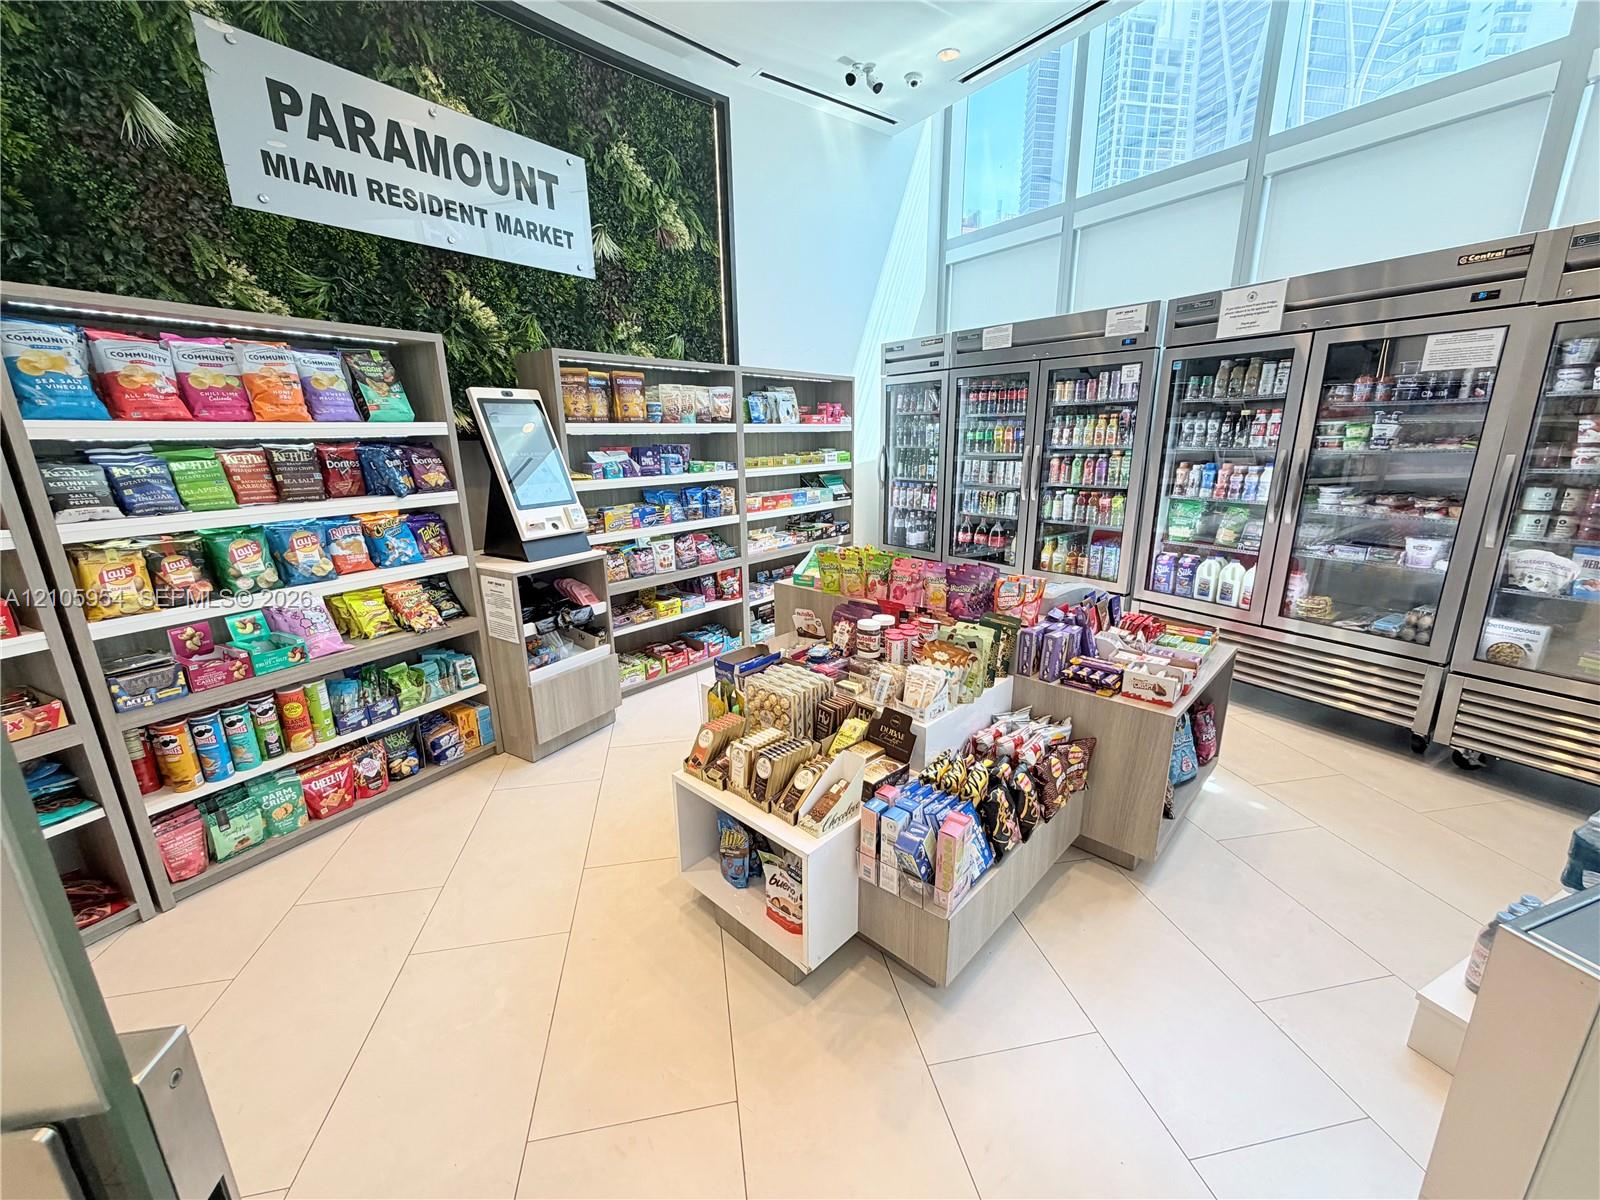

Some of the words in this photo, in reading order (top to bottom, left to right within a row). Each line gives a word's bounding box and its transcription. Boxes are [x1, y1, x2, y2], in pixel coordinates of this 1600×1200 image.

[265, 77, 559, 210] PARAMOUNT
[260, 149, 357, 197] MIAMI
[366, 177, 488, 229] RESIDENT
[495, 212, 574, 250] MARKET
[1469, 249, 1506, 262] Central
[6, 333, 76, 346] COMMUNITY
[110, 350, 168, 364] COMMUNITY
[181, 352, 236, 363] COMMUNITY
[248, 353, 293, 362] COMMUNIT
[34, 377, 55, 385] SEA
[326, 459, 361, 470] Doritos
[412, 456, 443, 466] Doritos
[48, 480, 100, 488] KRINKLE
[417, 526, 441, 543] Takis
[293, 535, 319, 549] Lay's
[233, 543, 259, 559] Lay's
[166, 559, 193, 572] Lay's
[1156, 565, 1171, 575] Silk
[1176, 567, 1193, 577] Silk
[101, 565, 136, 582] Lay's
[1487, 622, 1541, 637] bettergoods
[856, 635, 877, 643] nutella
[384, 730, 409, 742] NEW
[387, 736, 411, 749] YORK
[312, 771, 343, 791] CHEEZ-IT
[261, 792, 298, 810] CRISPS
[262, 787, 294, 802] PARM
[769, 873, 796, 896] bueno
